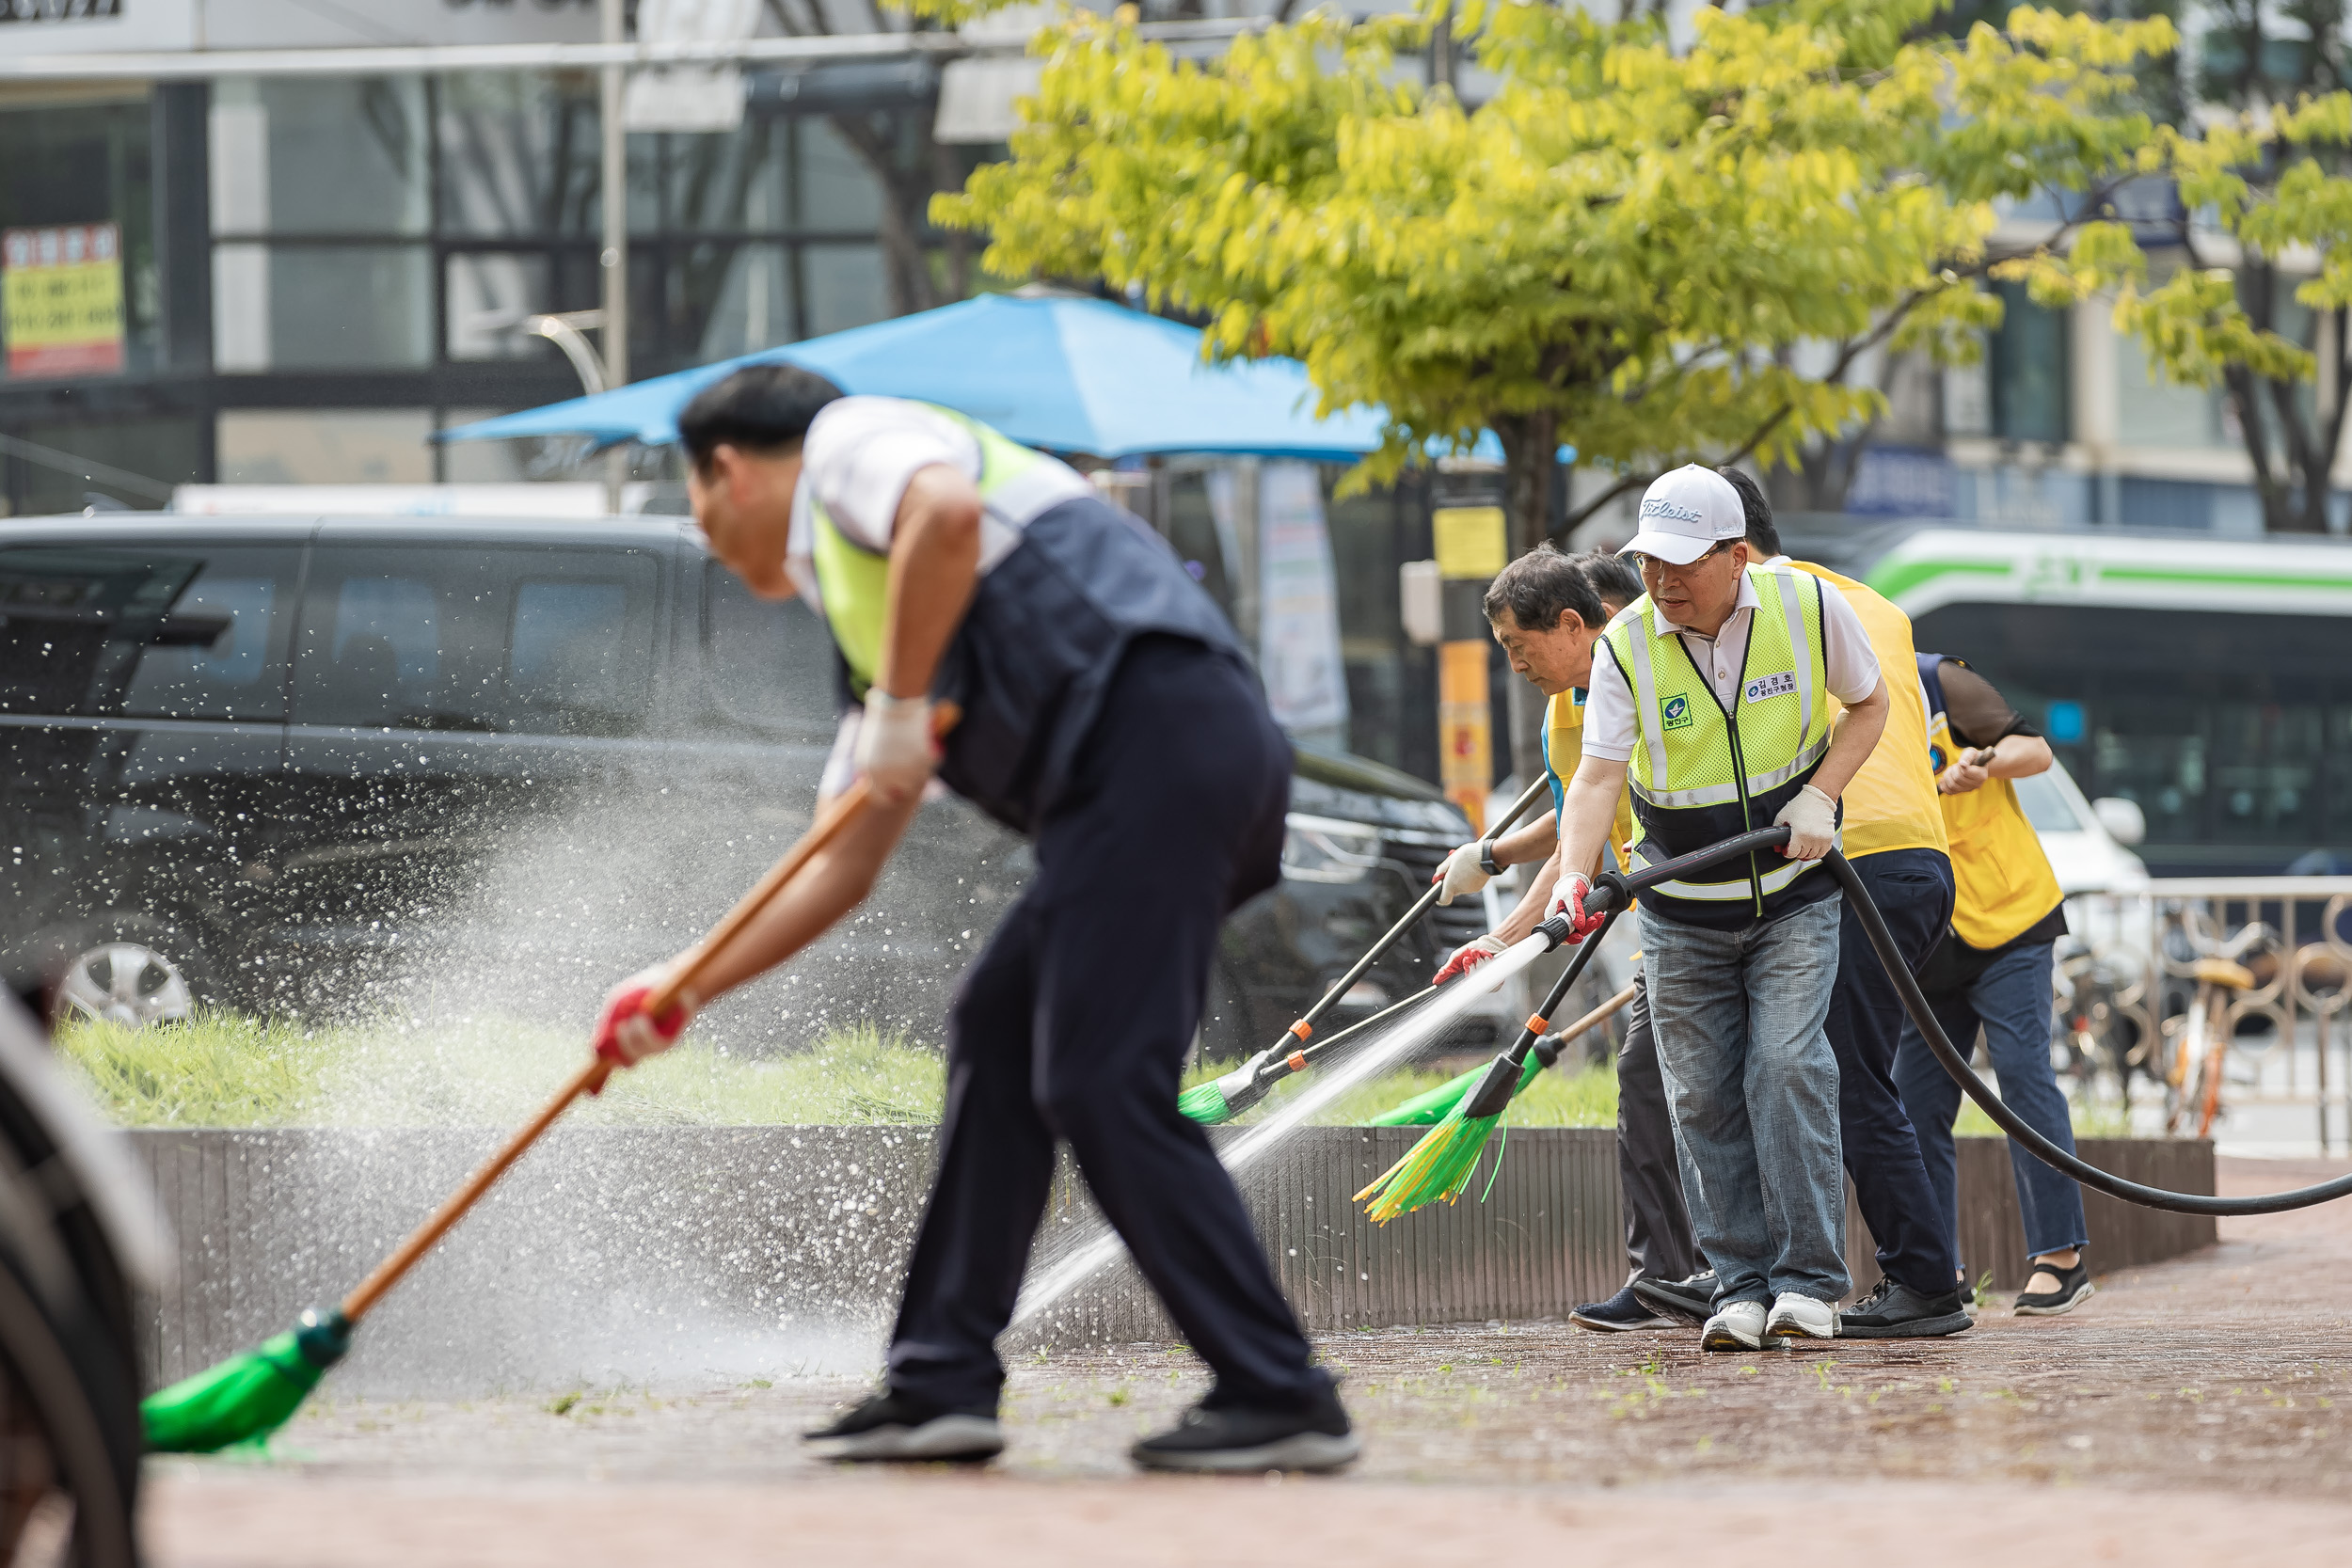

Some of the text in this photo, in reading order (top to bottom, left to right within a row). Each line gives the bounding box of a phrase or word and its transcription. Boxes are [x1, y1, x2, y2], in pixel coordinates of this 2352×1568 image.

[1640, 499, 1702, 523] Titleist
[1760, 683, 1794, 697] 광진구청장
[1666, 717, 1689, 726] 광진구
